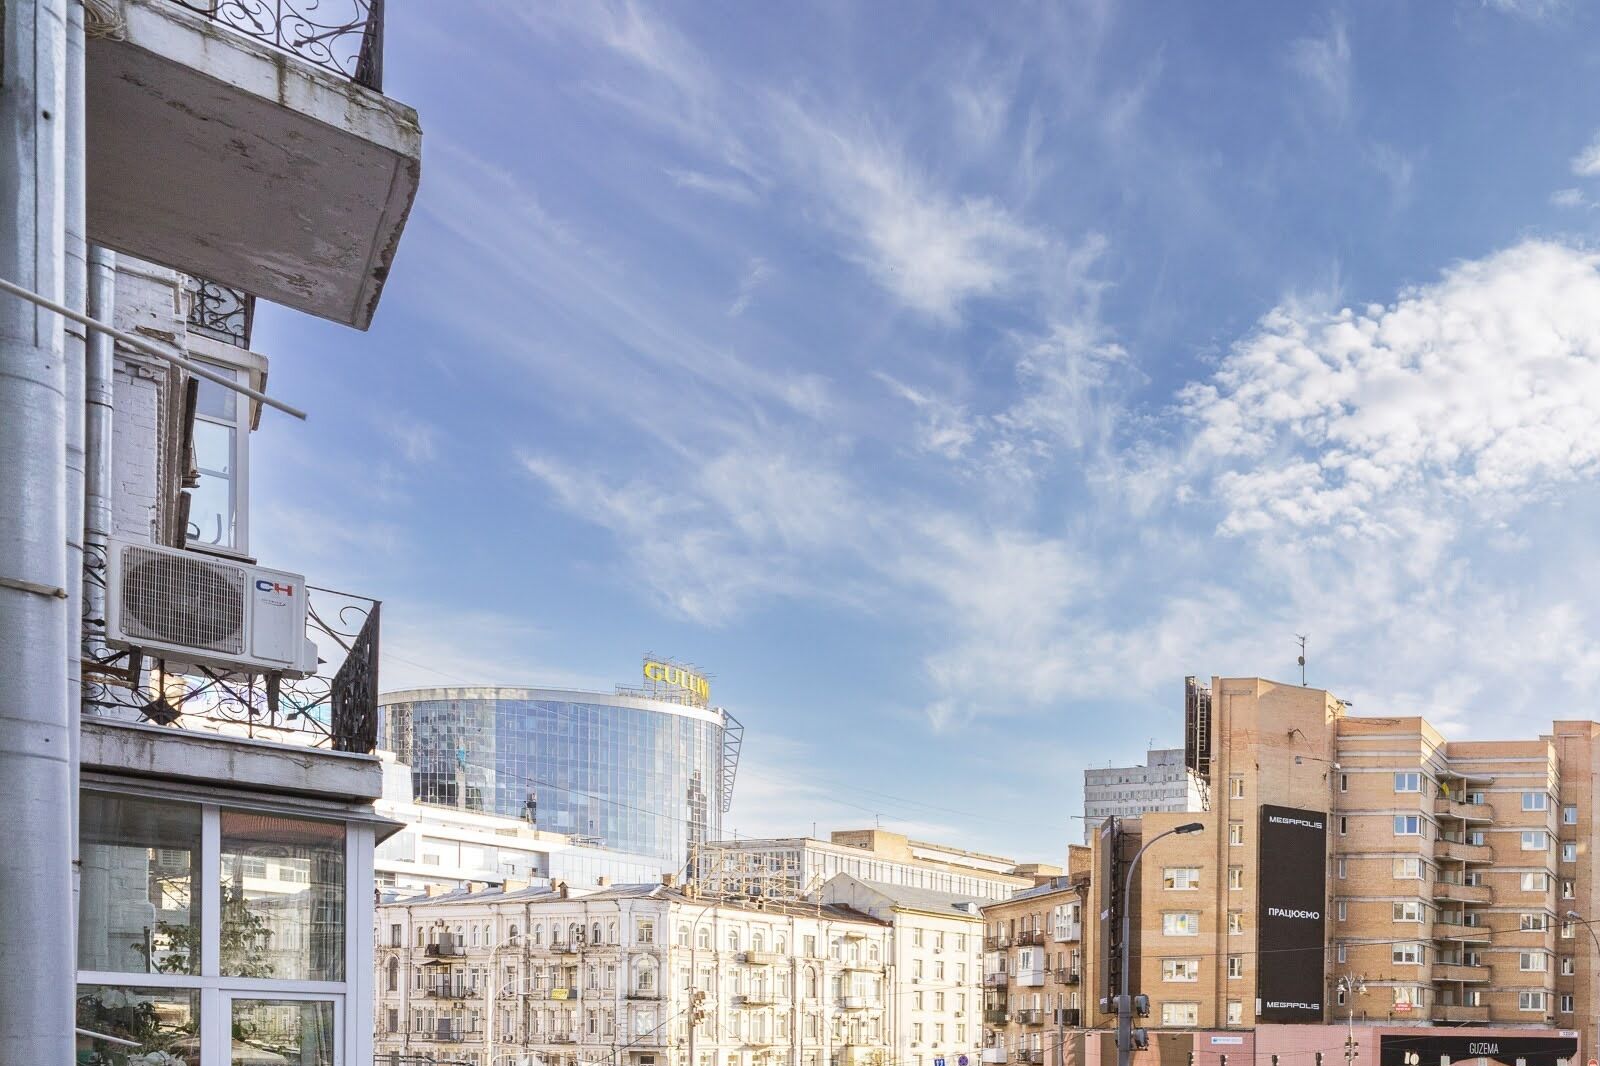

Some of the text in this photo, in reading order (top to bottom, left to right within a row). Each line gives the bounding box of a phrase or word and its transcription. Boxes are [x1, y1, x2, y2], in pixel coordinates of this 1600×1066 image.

[1269, 815, 1323, 829] MEGAPOLIS
[1268, 907, 1320, 920] ПРАЦЮЄМО
[1266, 1000, 1320, 1010] MEGAPOLIS
[1469, 1042, 1499, 1055] GUZEMA
